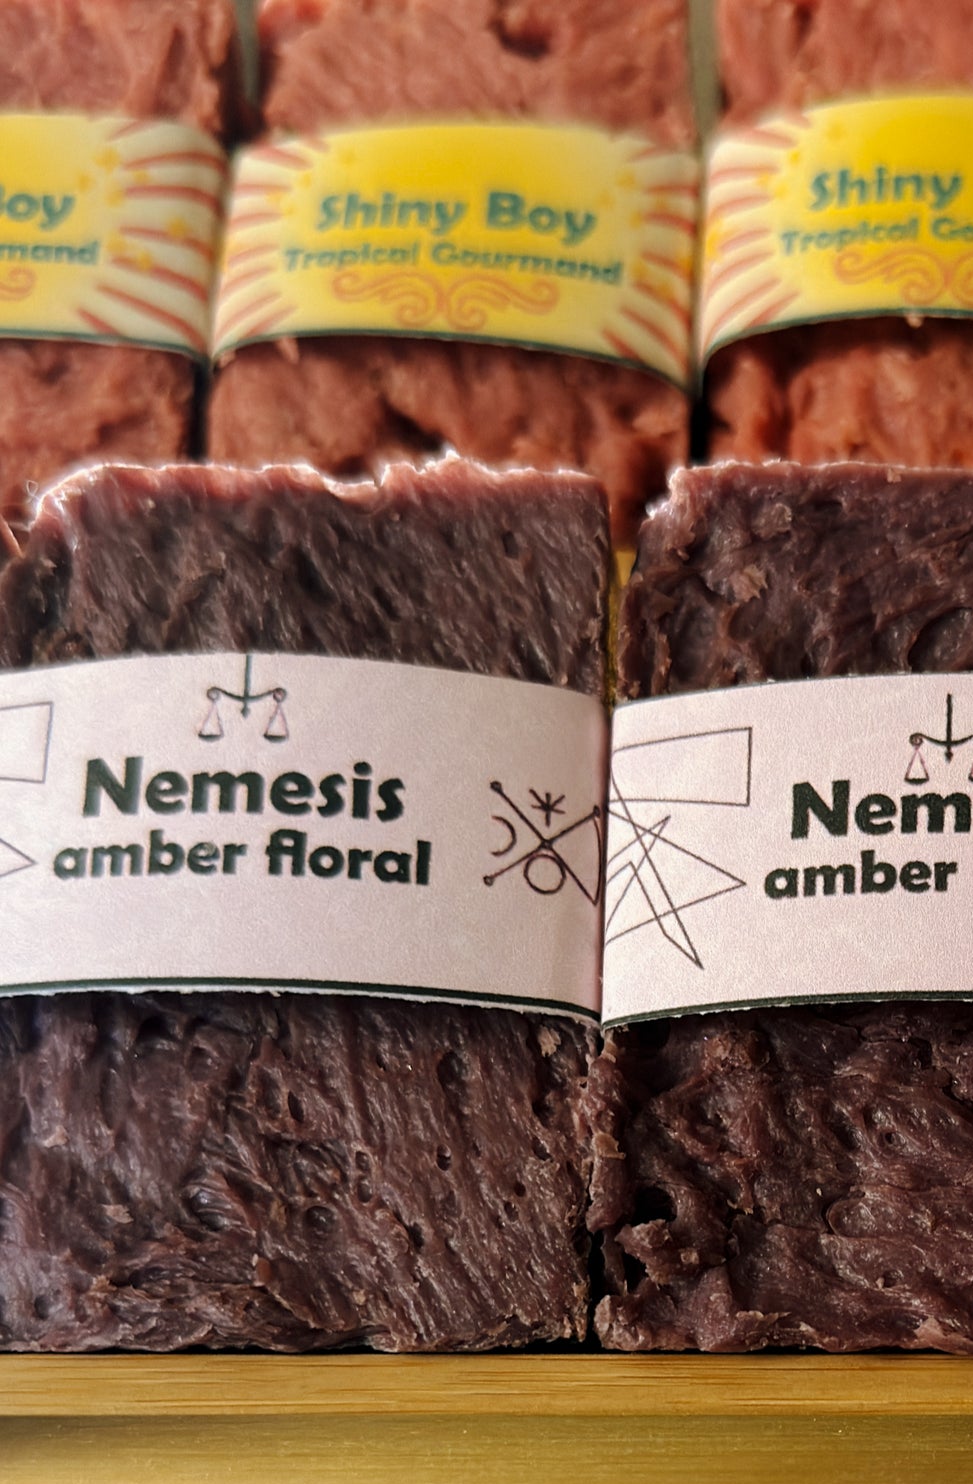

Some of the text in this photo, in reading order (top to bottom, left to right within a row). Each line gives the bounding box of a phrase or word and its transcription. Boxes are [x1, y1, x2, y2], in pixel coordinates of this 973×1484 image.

[0, 183, 76, 232] oy
[810, 165, 962, 211] Shiny
[317, 190, 596, 246] Shiny Boy
[780, 217, 921, 255] Tropical
[283, 240, 624, 287] Tropical Gourmand
[83, 756, 405, 822] Nemesis
[53, 829, 432, 886] amber floral
[764, 849, 957, 899] amber
